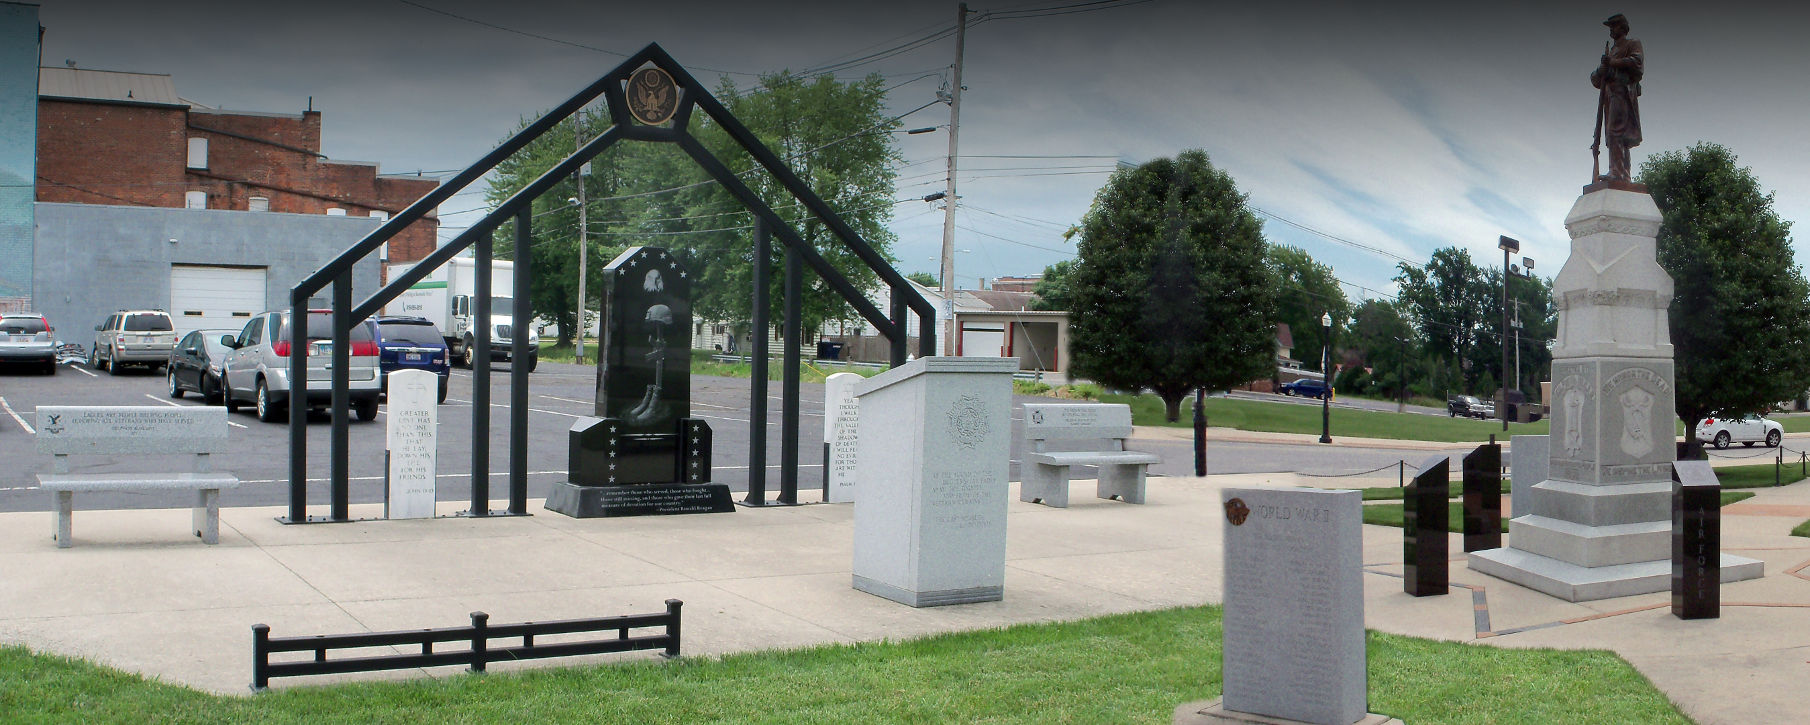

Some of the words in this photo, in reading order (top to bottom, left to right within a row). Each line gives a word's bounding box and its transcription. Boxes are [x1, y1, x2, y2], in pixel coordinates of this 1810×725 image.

[1250, 503, 1290, 520] WORLD
[1295, 507, 1320, 522] WAR
[1697, 505, 1705, 539] AIR
[1696, 544, 1706, 601] FORCE
